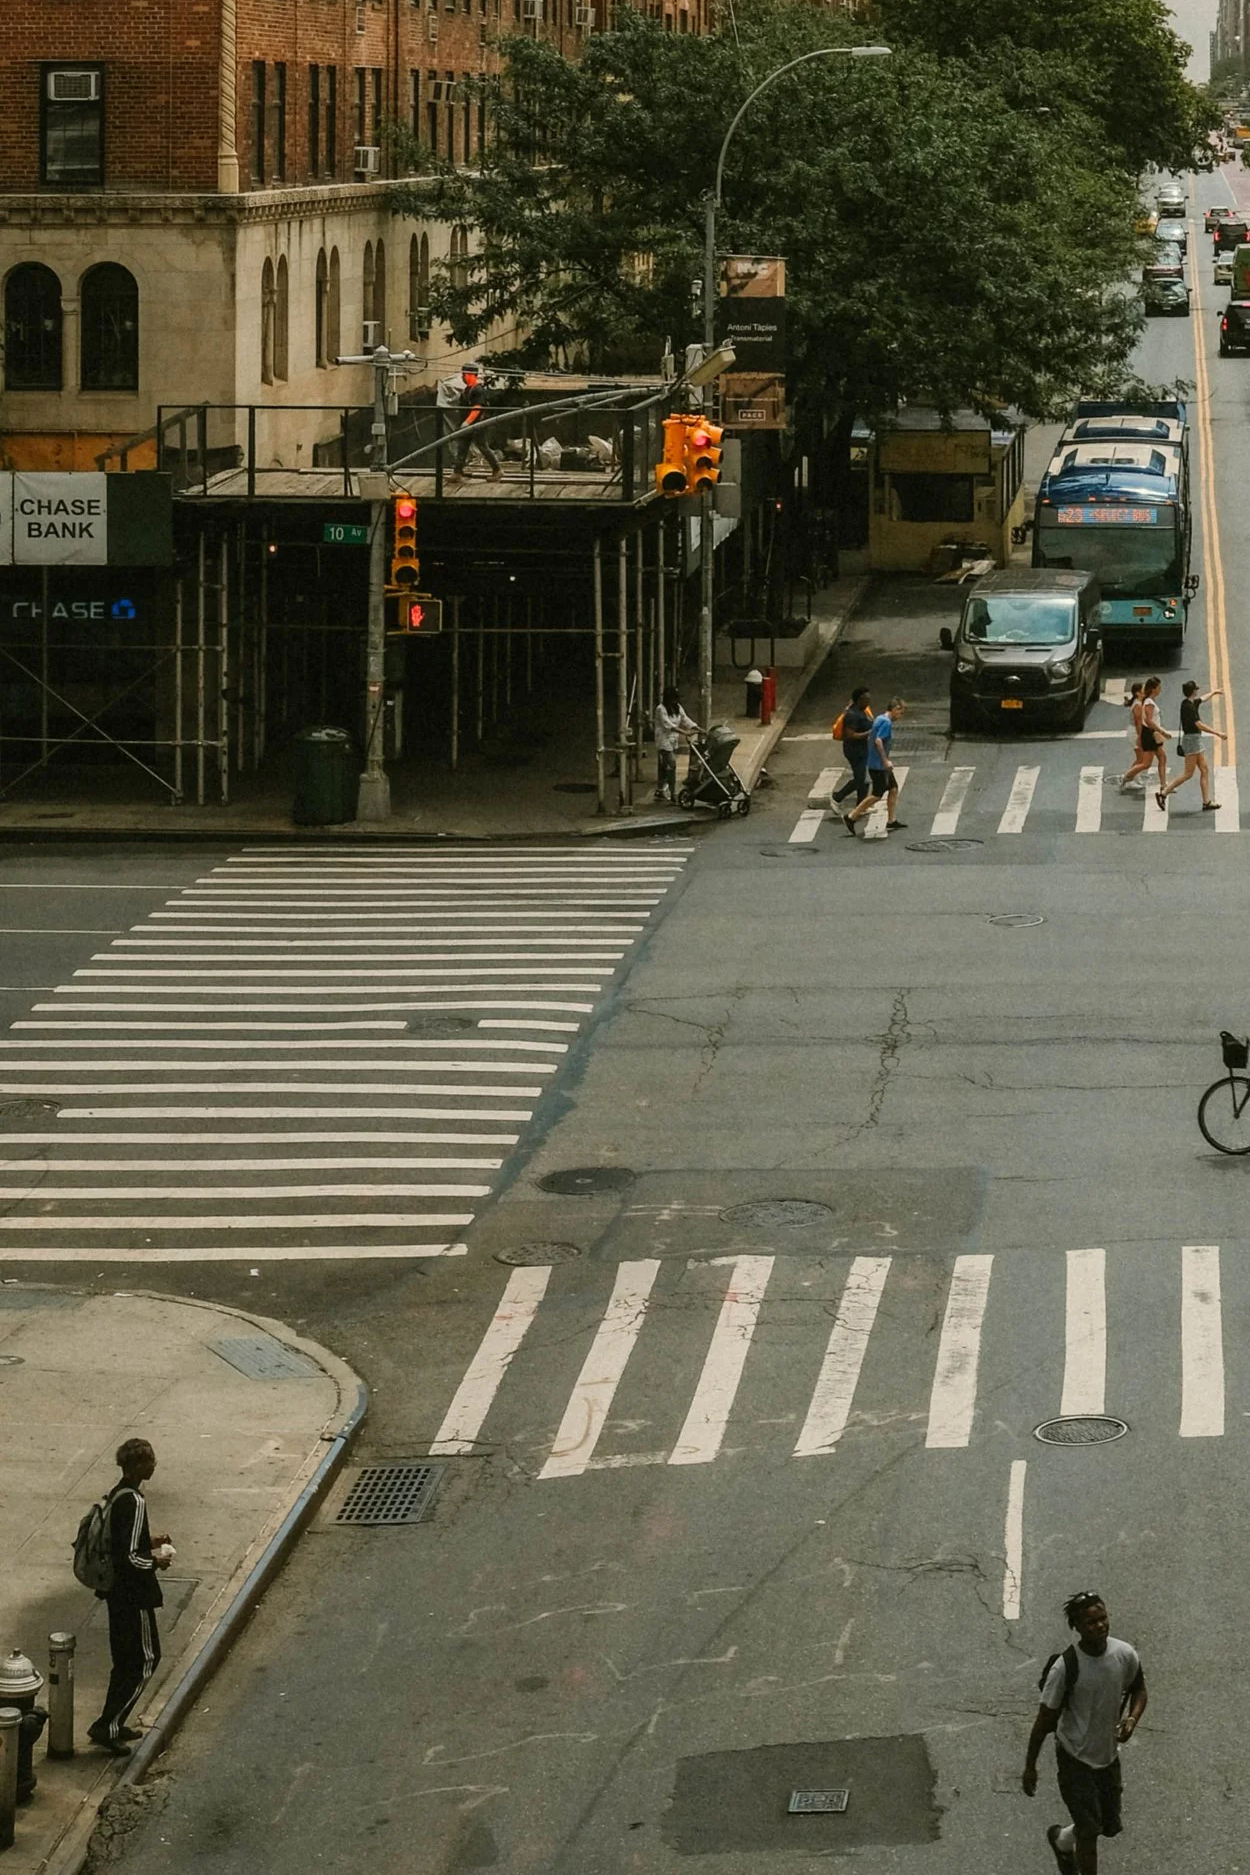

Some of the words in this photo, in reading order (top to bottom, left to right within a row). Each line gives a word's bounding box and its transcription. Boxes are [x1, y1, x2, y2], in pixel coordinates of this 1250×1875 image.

[19, 498, 101, 516] CHASE
[27, 522, 95, 539] BANK
[330, 527, 345, 541] 10
[351, 527, 363, 537] Av
